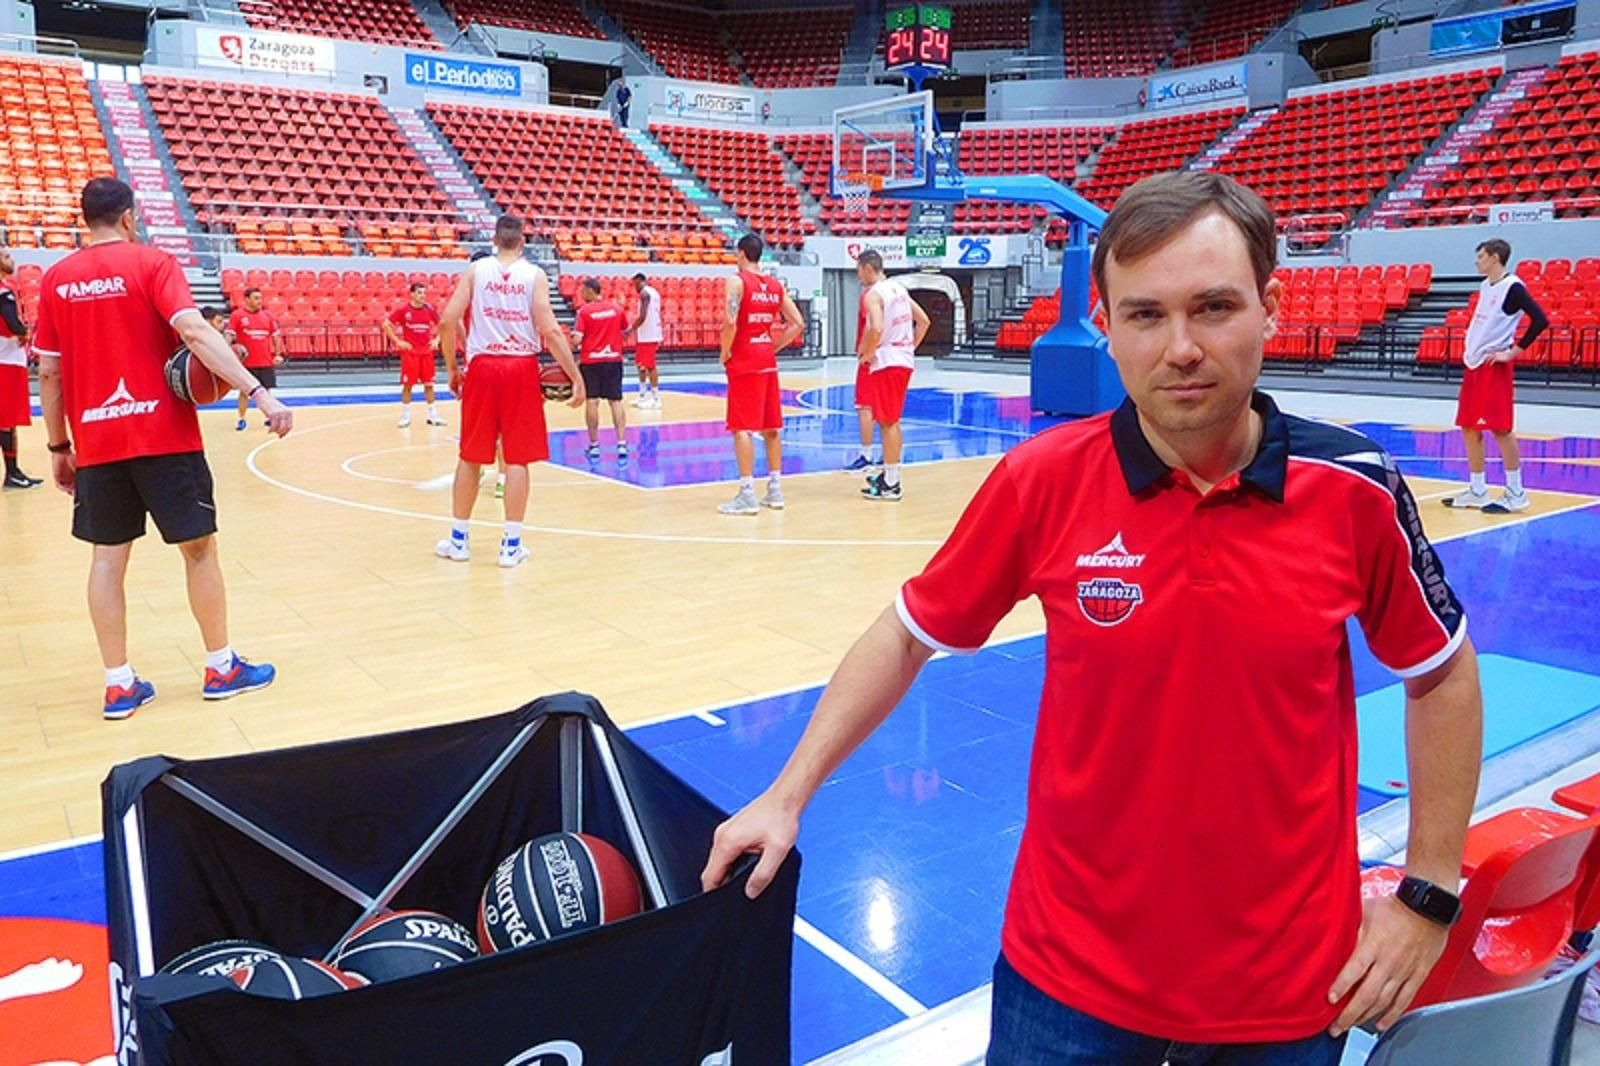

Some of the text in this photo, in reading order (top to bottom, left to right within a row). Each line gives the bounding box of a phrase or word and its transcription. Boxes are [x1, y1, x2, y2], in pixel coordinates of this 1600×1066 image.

[248, 37, 315, 57] Zaragoza
[889, 31, 914, 63] 24
[921, 28, 949, 59] 24
[69, 276, 127, 298] AMBAR
[484, 281, 527, 295] AMBAR
[81, 400, 160, 423] MERCURY
[1075, 553, 1146, 568] MERCURY
[1402, 491, 1458, 616] MERCURY
[1078, 585, 1139, 600] ZARAGOZA
[495, 847, 536, 948] PALDING
